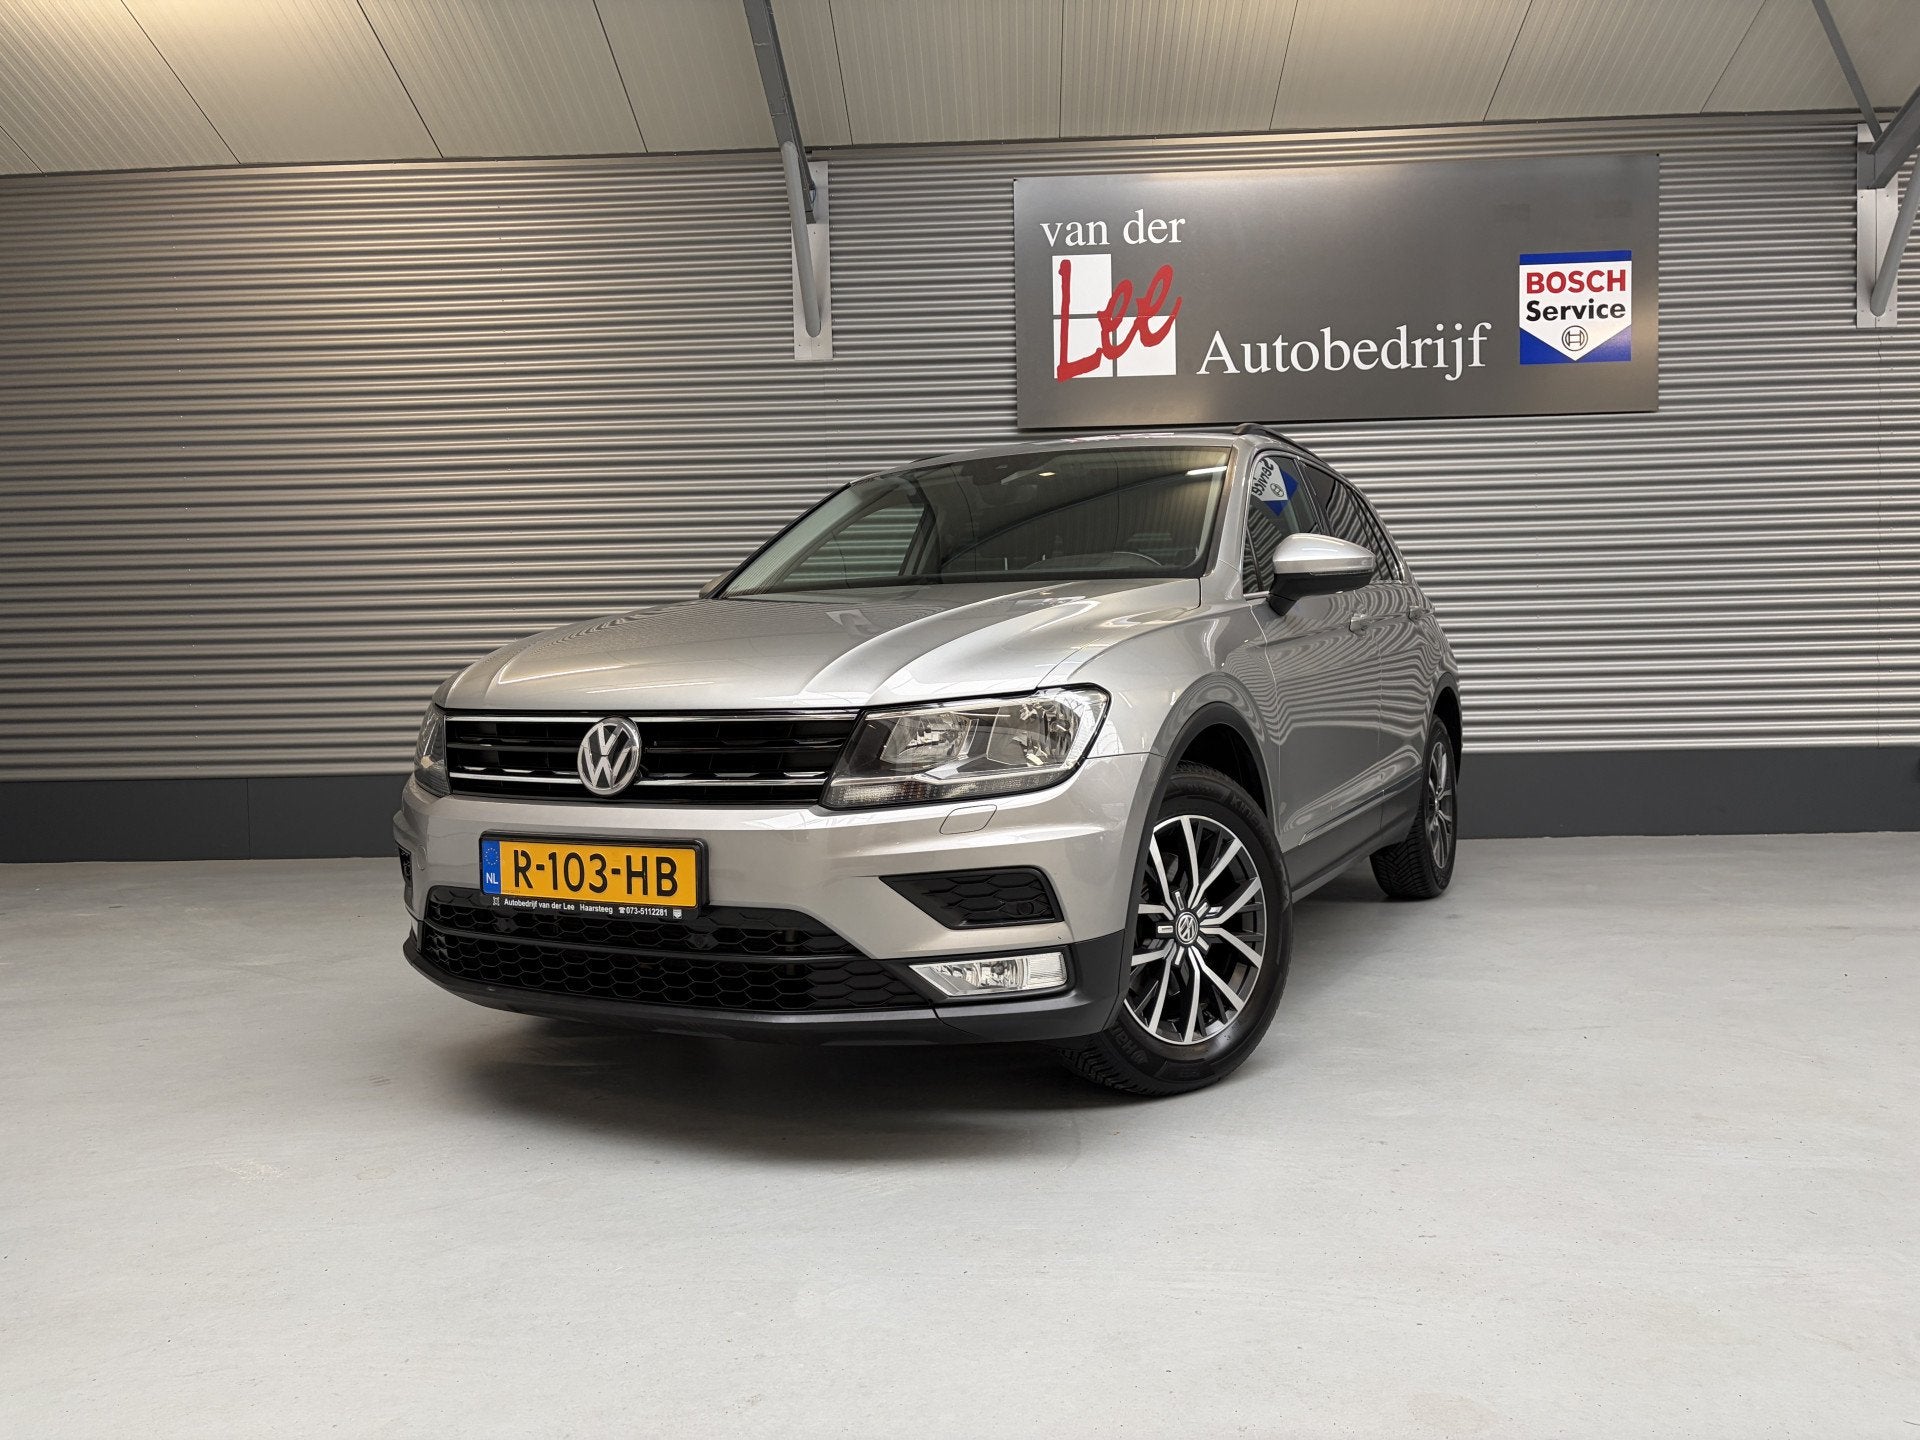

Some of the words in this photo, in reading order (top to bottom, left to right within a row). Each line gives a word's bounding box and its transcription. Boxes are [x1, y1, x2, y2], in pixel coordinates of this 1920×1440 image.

[1040, 219, 1111, 247] van
[1122, 209, 1186, 245] der
[1525, 268, 1627, 296] BOSCH
[1056, 258, 1183, 383] Lee
[1525, 297, 1627, 322] Service
[1196, 322, 1493, 382] Autobedrijf
[485, 872, 499, 885] NL
[513, 849, 678, 897] R-103-HB
[503, 898, 538, 909] Autobedrijf
[551, 901, 562, 910] der
[563, 902, 575, 911] Lee
[579, 903, 613, 915] Haarsteeg
[625, 906, 668, 917] 073-5112281
